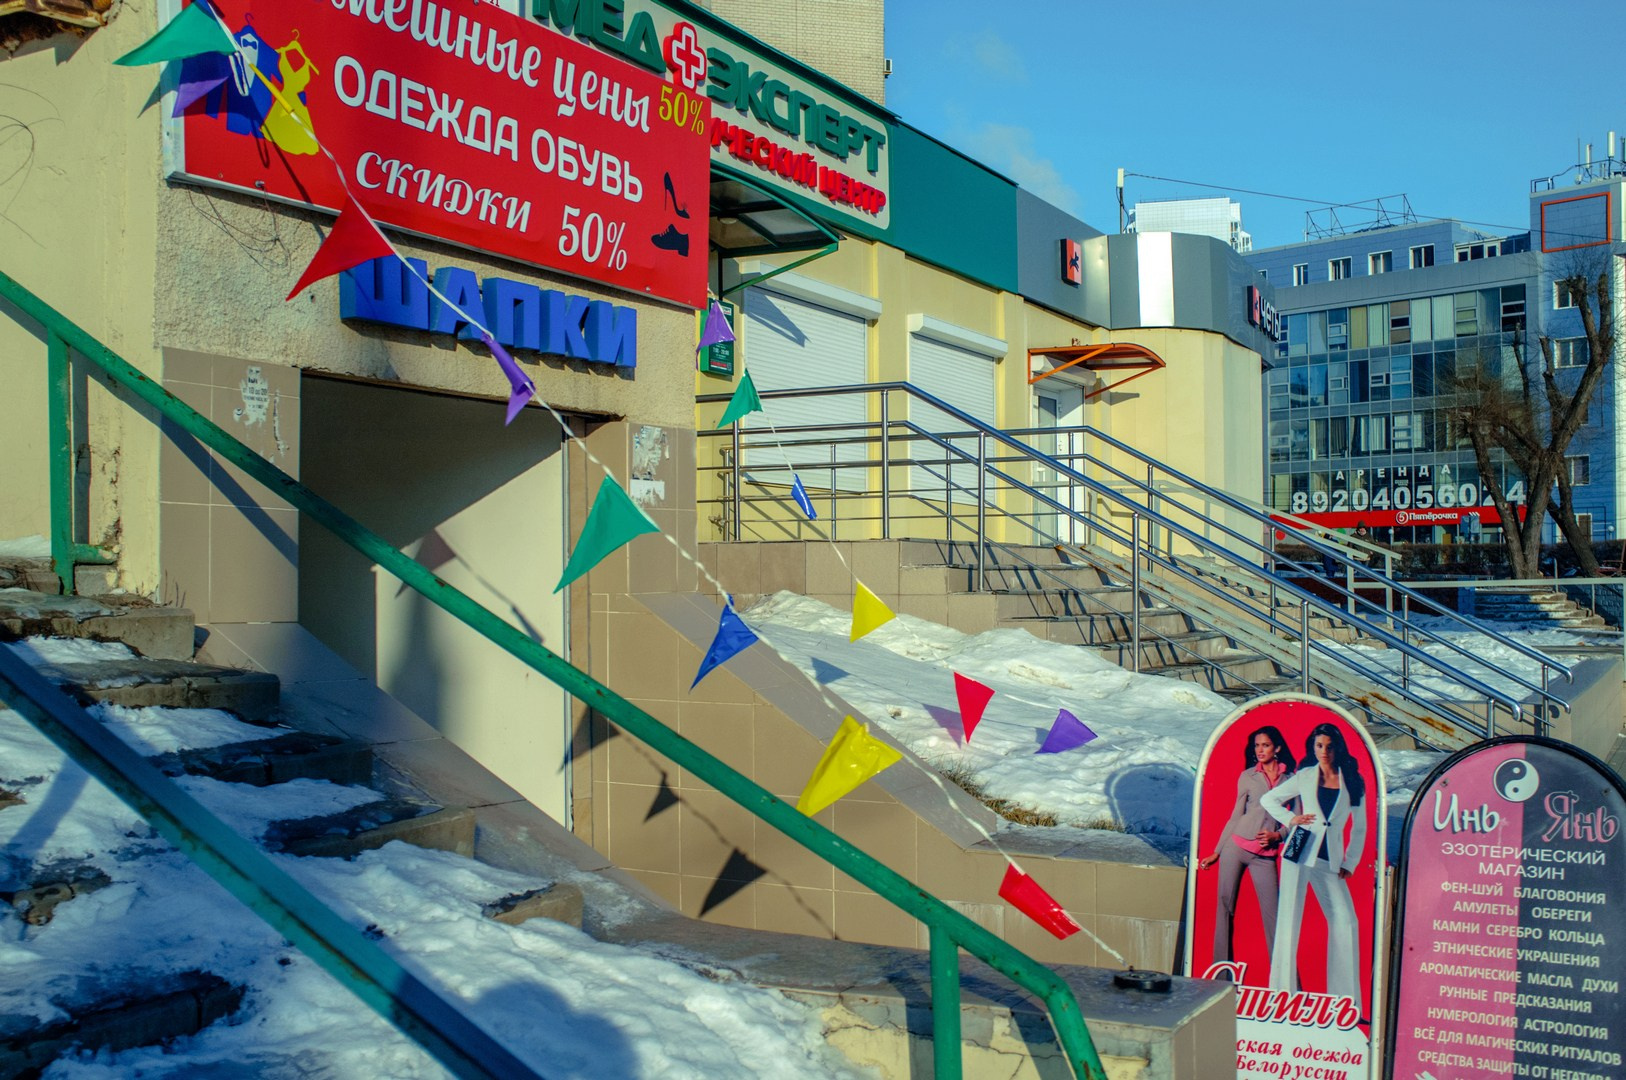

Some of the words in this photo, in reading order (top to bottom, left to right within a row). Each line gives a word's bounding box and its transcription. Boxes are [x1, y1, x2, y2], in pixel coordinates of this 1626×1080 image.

[331, 0, 542, 87] мешные
[553, 57, 650, 133] цены
[659, 84, 705, 135] 50%
[531, 0, 667, 73] МЕД
[707, 47, 886, 173] ЭКСПЕРТ
[333, 55, 518, 161] ОДЕЖДА
[531, 129, 643, 203] ОБУВЬ
[819, 165, 887, 214] ЦЕНТР
[356, 151, 531, 233] СКИДКИ
[558, 204, 628, 271] 50%
[340, 256, 637, 368] ШАПКИ
[1336, 464, 1450, 481] АРЕНДА
[1408, 512, 1459, 521] Пятёрочка
[1433, 790, 1500, 834] Инь
[1542, 789, 1620, 842] Янь
[1441, 842, 1606, 865] ЭЗОТЕРИЧЕСКИЙ
[1479, 862, 1565, 880] МАГАЗИН
[1441, 881, 1503, 896] ФЕН-ШУЙ
[1513, 887, 1606, 904] БЛАГОВОНИЯ
[1453, 901, 1518, 916] АМУЛЕТЫ
[1532, 907, 1592, 922] ОБЕРЕГИ
[1433, 920, 1480, 934] КАМНИ
[1486, 924, 1542, 939] СЕРЕБРО
[1549, 929, 1605, 946] КОЛЬЦА
[1433, 941, 1513, 959] ЭТНИЧЕСКИЕ
[1517, 948, 1600, 968] УКРАШЕНИЯ
[1419, 962, 1521, 983] АРОМАТИЧЕСКИЕ
[1527, 973, 1573, 989] МАСЛА
[1582, 978, 1619, 994] ДУХИ
[1440, 986, 1487, 1001] РУННЫЕ
[1494, 991, 1592, 1013] ПРЕДСКАЗАНИЯ
[1427, 1007, 1518, 1028] НУМЕРОЛОГИЯ
[1524, 1018, 1608, 1040] АСТРОЛОГИЯ
[1236, 1038, 1283, 1056] ская
[1292, 1042, 1362, 1065] одежда
[1414, 1026, 1435, 1041] ВСЁ
[1437, 1030, 1463, 1044] ДЛЯ
[1466, 1034, 1549, 1056] МАГИЧЕСКИХ
[1551, 1045, 1622, 1066] РИТУАЛОВ
[1236, 1054, 1347, 1080] Белоруссии
[1418, 1050, 1474, 1068] СРЕДСТВА
[1477, 1058, 1529, 1076] ЗАЩИТЫ
[1532, 1065, 1548, 1078] ОТ
[1551, 1067, 1612, 1080] НЕГАТИ
